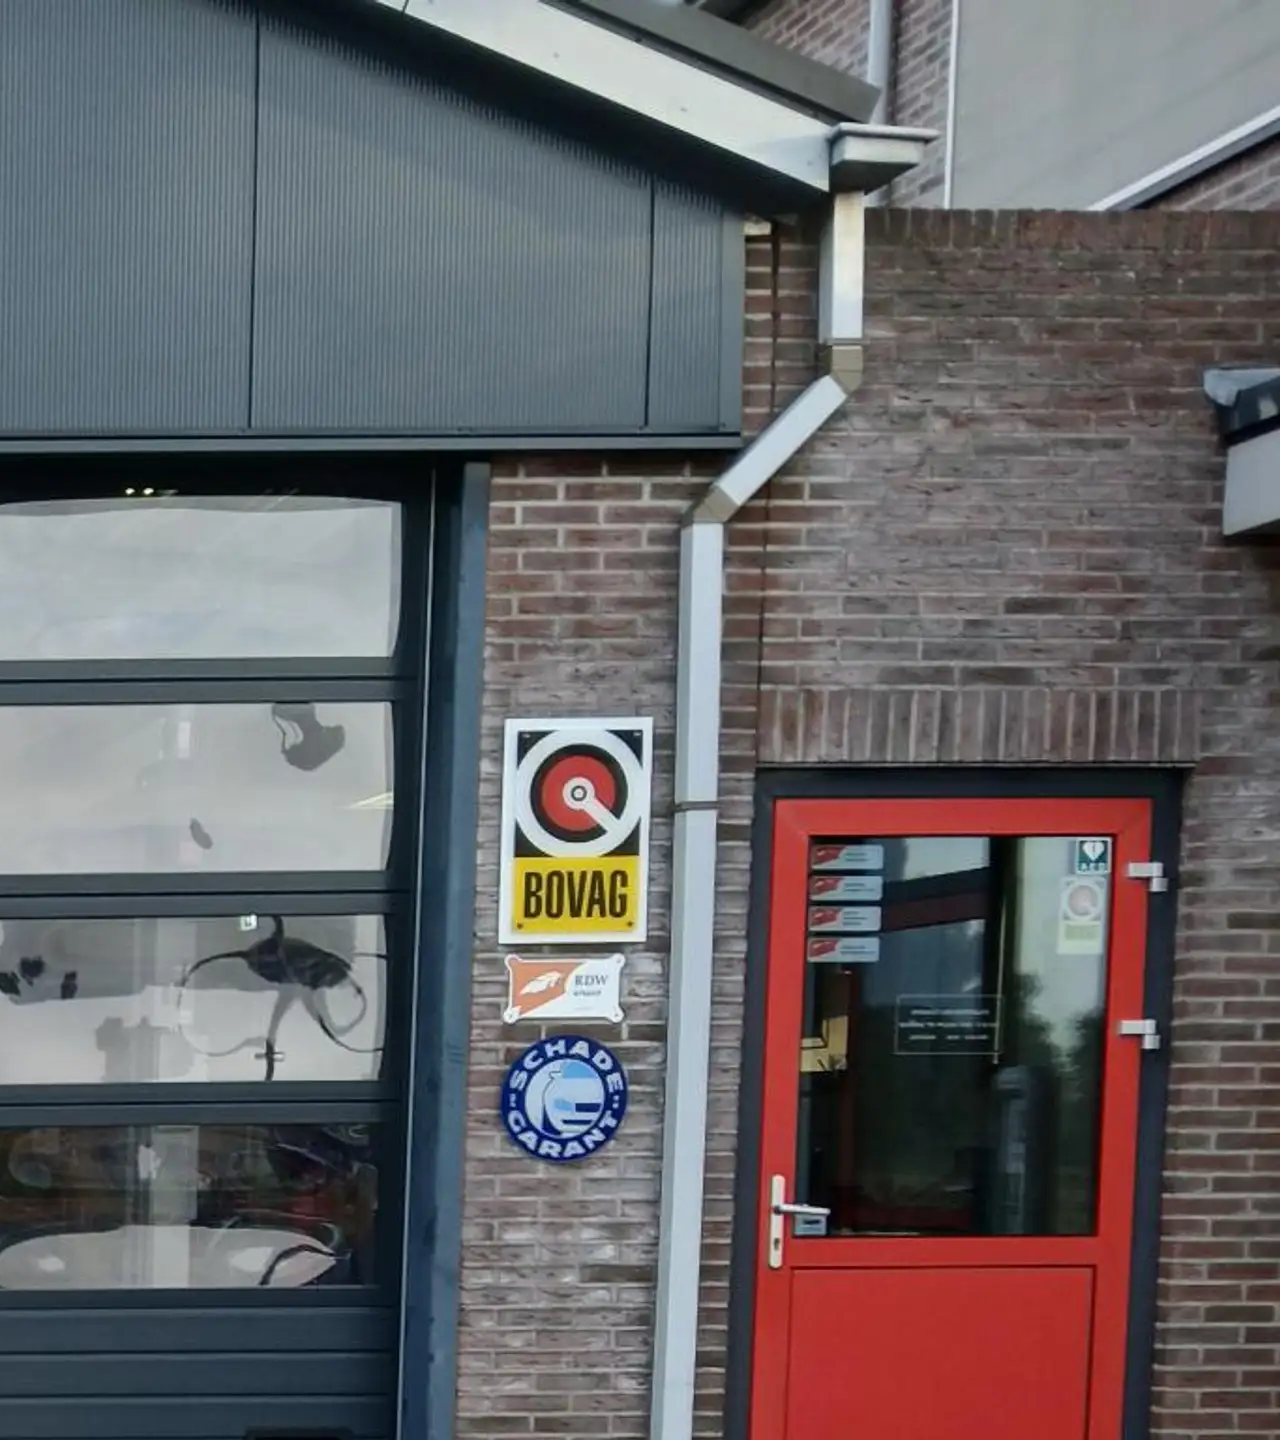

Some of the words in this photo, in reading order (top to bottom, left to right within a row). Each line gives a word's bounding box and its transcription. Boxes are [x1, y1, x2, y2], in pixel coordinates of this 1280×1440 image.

[523, 870, 629, 919] BOVAG
[574, 974, 609, 986] RDW
[509, 1039, 624, 1093] SCHADE
